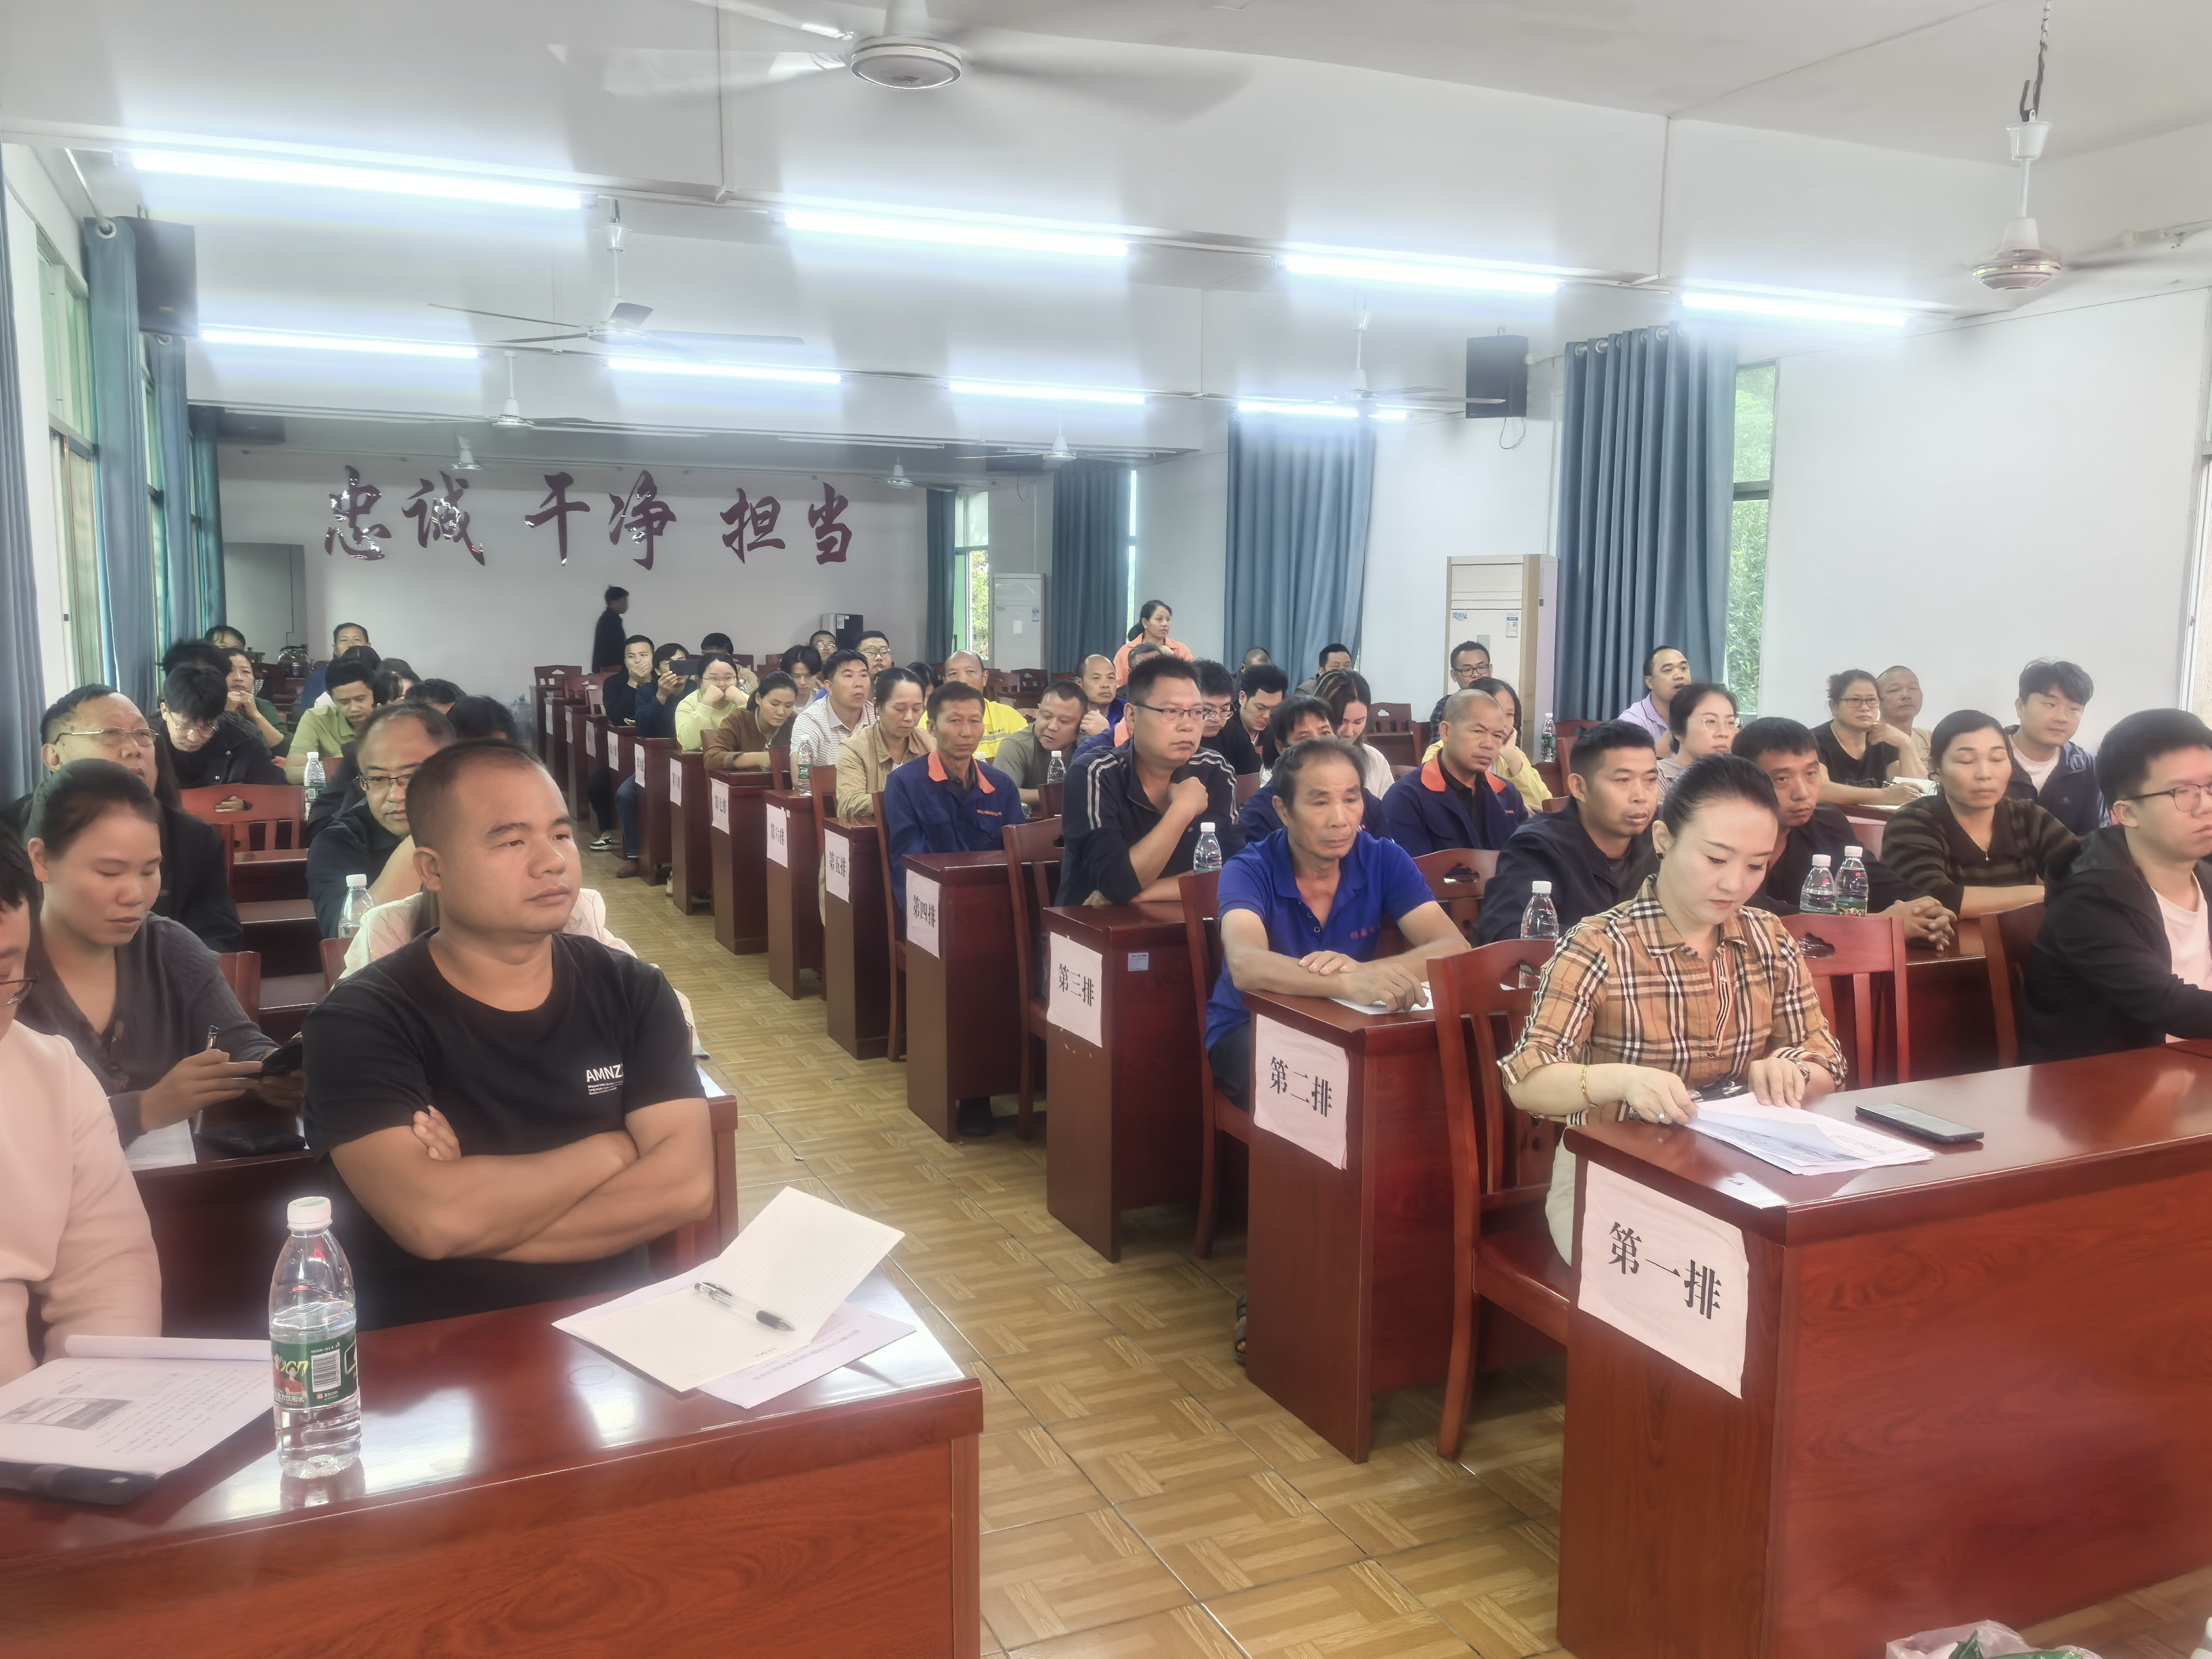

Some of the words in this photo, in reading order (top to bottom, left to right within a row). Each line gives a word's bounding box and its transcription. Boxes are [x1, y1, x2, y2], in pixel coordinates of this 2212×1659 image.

[324, 465, 485, 566] 忠诚
[524, 470, 677, 570] 干净
[720, 482, 852, 565] 担当
[830, 851, 846, 878] 第五排
[913, 894, 935, 928] 第四排
[1058, 963, 1094, 1007] 第三排
[586, 1062, 624, 1082] AMNZ
[1270, 1056, 1333, 1117] 第二排
[1608, 1222, 1722, 1319] 第一排
